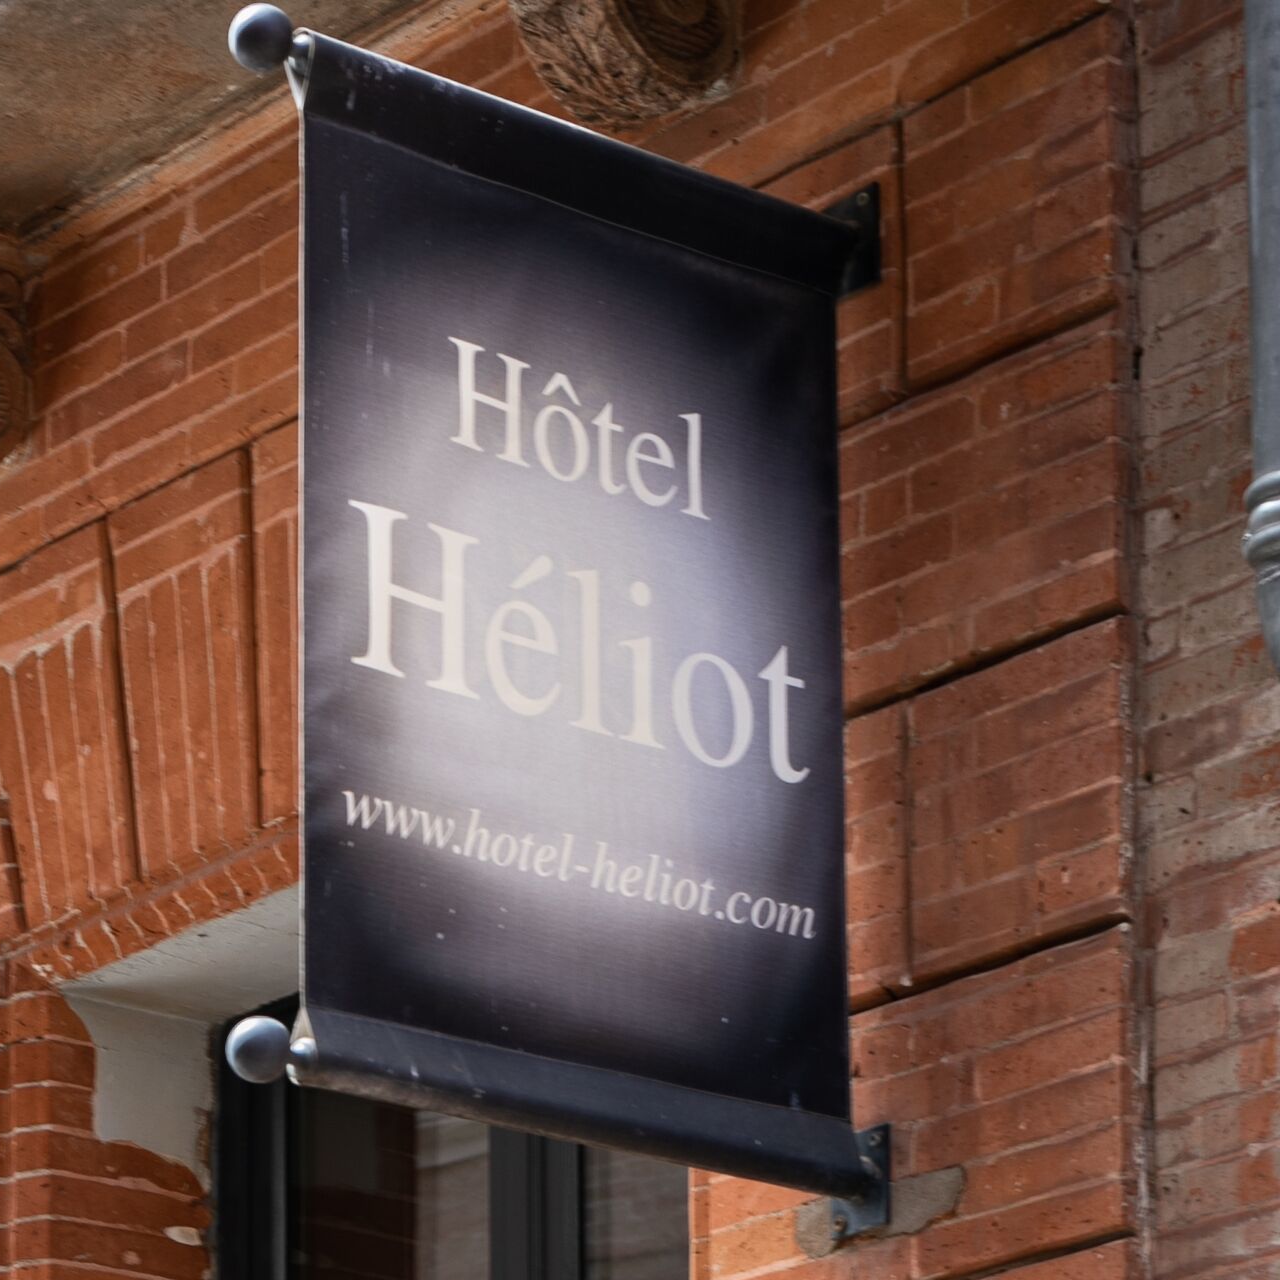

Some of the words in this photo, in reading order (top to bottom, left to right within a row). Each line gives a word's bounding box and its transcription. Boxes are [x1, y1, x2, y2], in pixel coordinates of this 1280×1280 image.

[448, 336, 711, 520] Hôtel
[348, 499, 811, 785] Héliot
[341, 788, 817, 939] www.hotel-heliot.com
